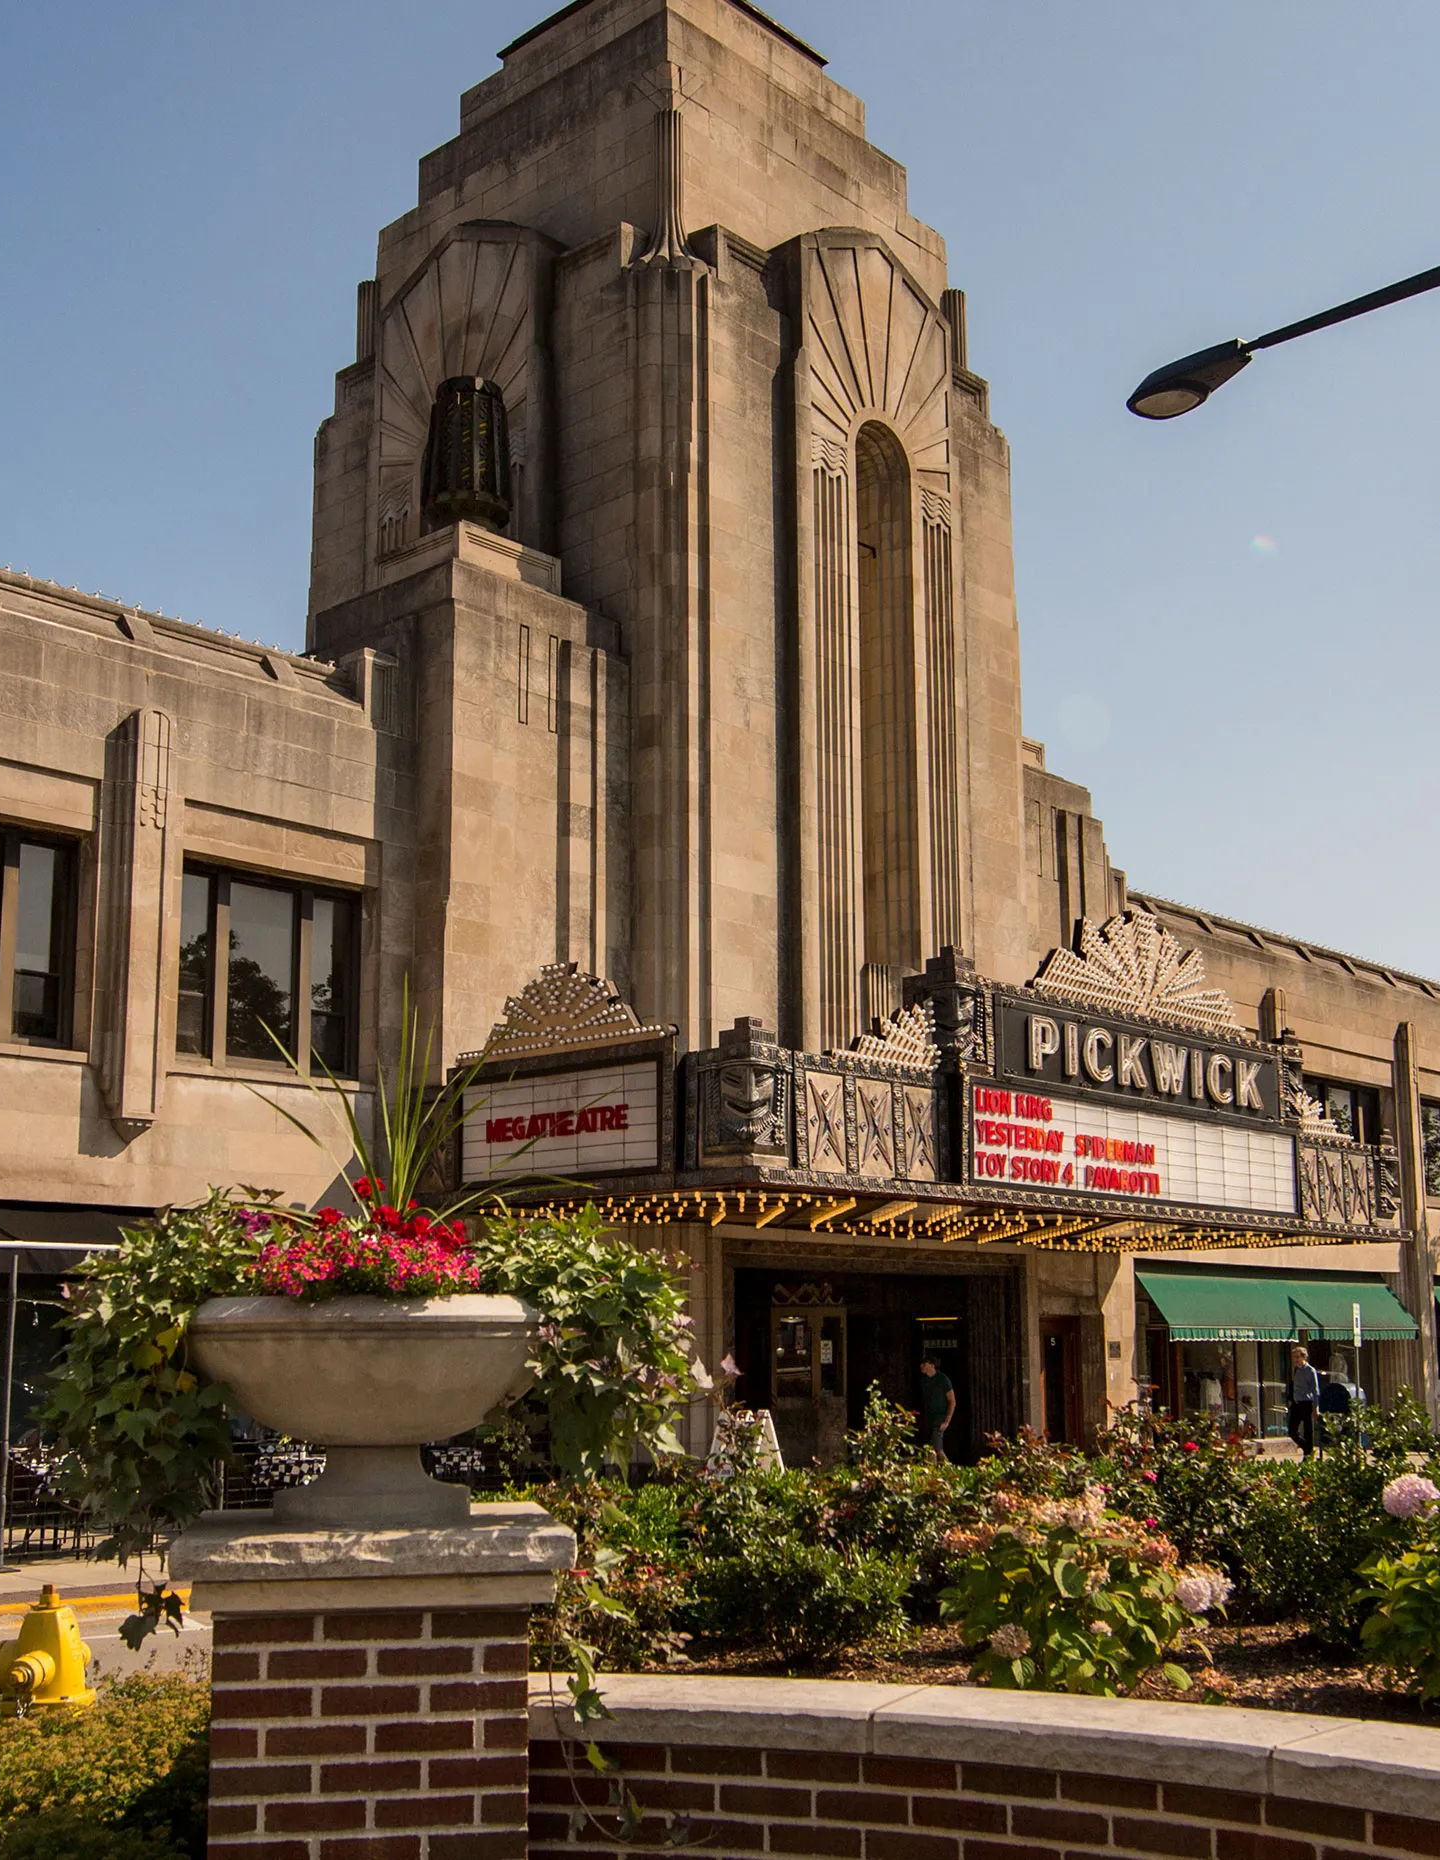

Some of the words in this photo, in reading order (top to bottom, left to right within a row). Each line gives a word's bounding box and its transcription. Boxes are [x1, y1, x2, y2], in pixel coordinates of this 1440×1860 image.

[1028, 1013, 1265, 1111] PICKWICK
[975, 1087, 1012, 1116] LION
[1015, 1093, 1053, 1122] KING
[975, 1119, 1065, 1154] YESTERDAY
[1075, 1133, 1156, 1166] SPIDERMAN
[975, 1151, 1008, 1178] TOY
[1011, 1156, 1061, 1185] STORY
[1062, 1162, 1075, 1186] 4
[1085, 1165, 1161, 1196] PAVAROTTI
[1050, 1337, 1056, 1346] 5
